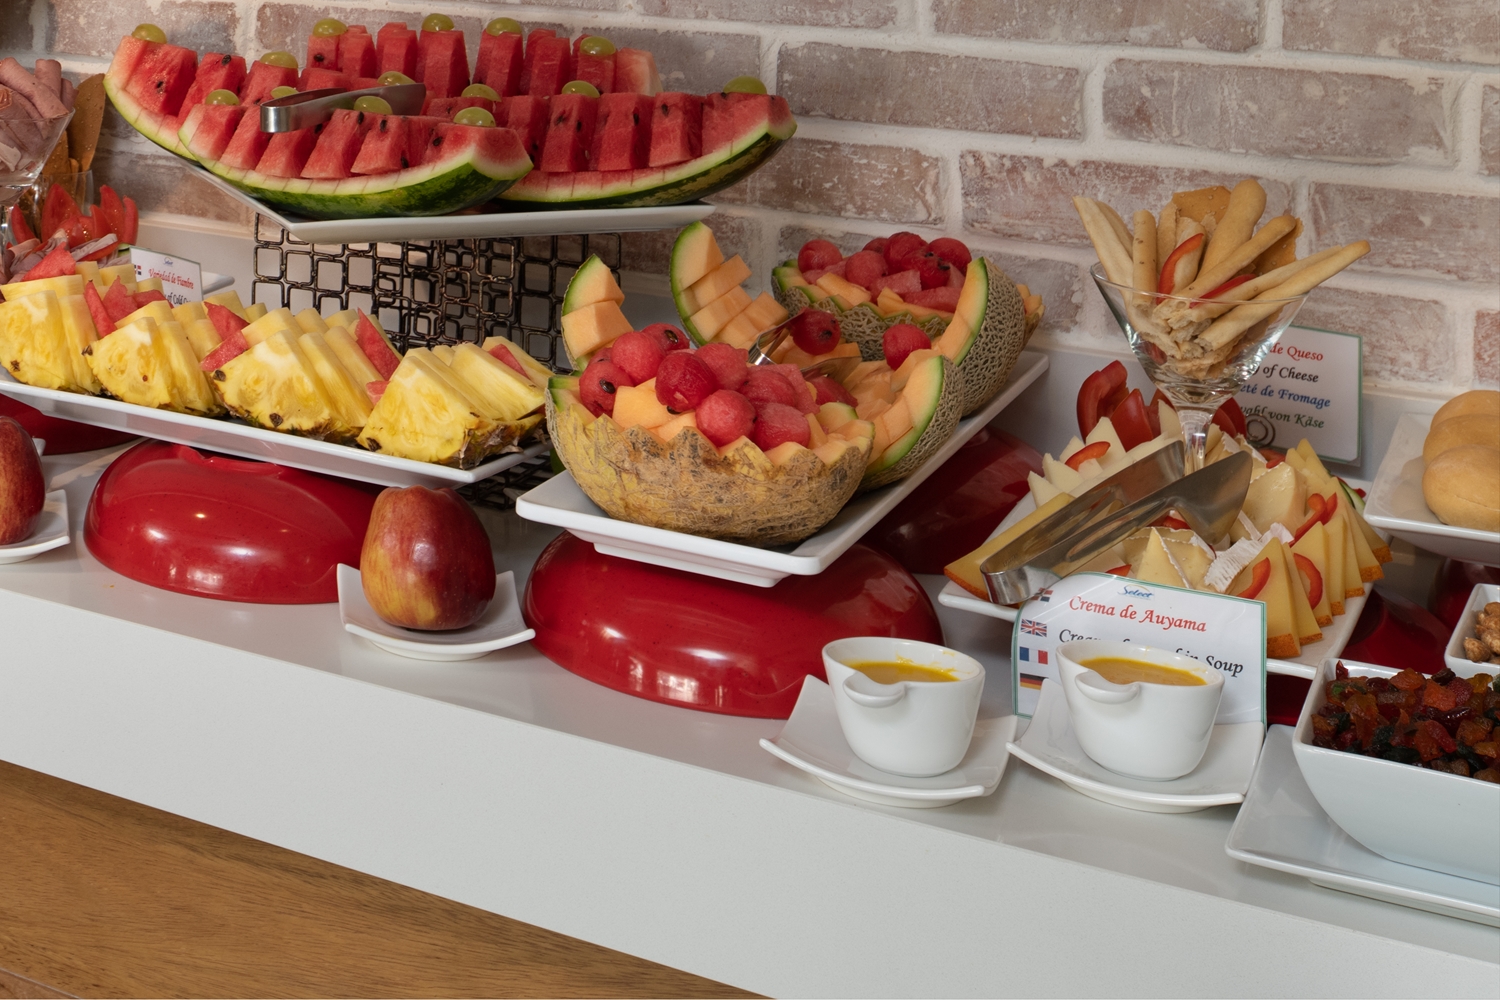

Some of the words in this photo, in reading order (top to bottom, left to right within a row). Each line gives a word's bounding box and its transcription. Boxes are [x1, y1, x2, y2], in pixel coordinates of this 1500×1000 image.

[1270, 342, 1283, 354] de
[1287, 346, 1324, 361] Queso
[1263, 364, 1278, 378] of
[1279, 366, 1319, 382] Cheese
[1260, 385, 1274, 397] de
[1278, 389, 1331, 410] Fromage
[1268, 411, 1290, 423] von
[1294, 414, 1325, 429] Käse
[1121, 586, 1154, 598] Select
[1069, 596, 1115, 617] Crema
[1119, 604, 1137, 620] de
[1139, 609, 1207, 632] Auyama
[1205, 655, 1244, 678] Soup
